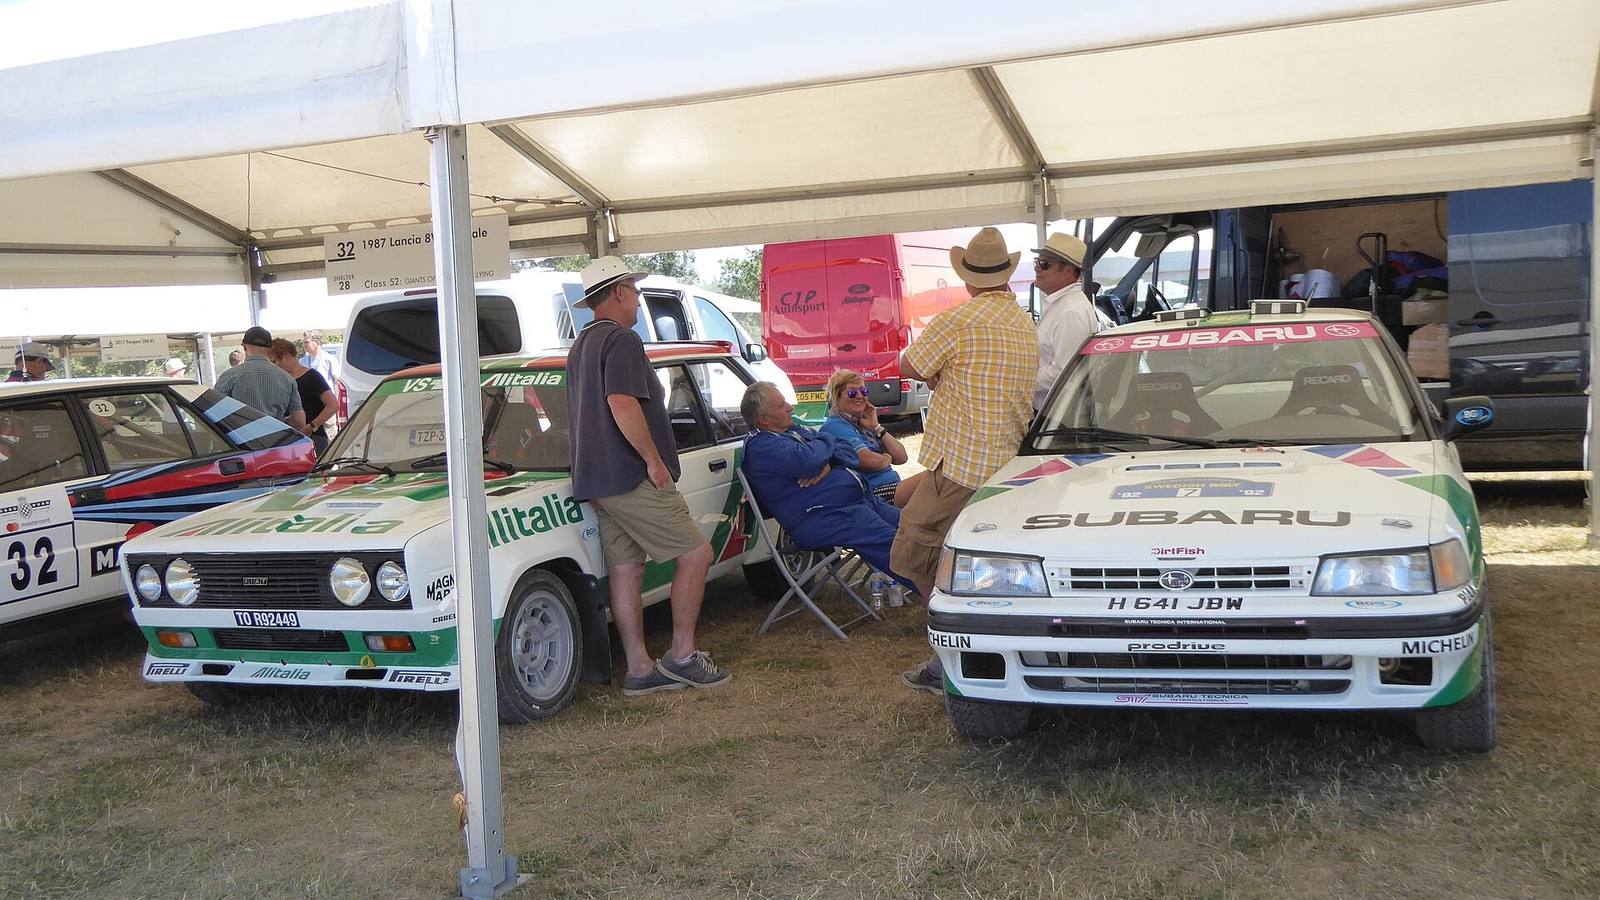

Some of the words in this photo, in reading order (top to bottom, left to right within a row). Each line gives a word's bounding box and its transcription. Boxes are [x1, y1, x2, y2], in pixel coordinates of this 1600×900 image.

[362, 238, 386, 250] 1987
[390, 234, 421, 248] Lancia
[336, 241, 355, 258] 32
[338, 280, 351, 291] 28
[364, 279, 387, 289] Class
[389, 277, 402, 287] 52:
[404, 276, 426, 285] GIANTS
[780, 290, 817, 306] CJP
[773, 301, 826, 315] Autosport
[1130, 325, 1317, 349] SUBARU
[480, 371, 563, 387] Alitalia
[1303, 374, 1351, 385] RECARO
[1137, 382, 1182, 392] RECARO
[94, 402, 110, 413] 32
[1144, 481, 1206, 490] SWEDISH
[1021, 509, 1351, 531] SUBARU
[1151, 547, 1205, 556] DirtFish
[7, 536, 58, 591] 32
[242, 576, 269, 586] FIAT
[1107, 597, 1127, 610] H
[1133, 597, 1179, 610] 641
[1187, 597, 1243, 611] JBW
[236, 611, 251, 626] TO
[253, 612, 298, 627] R92449
[1127, 640, 1226, 652] prodrive
[1401, 630, 1474, 655] MICHELIN
[145, 662, 191, 676] PIRELLI
[250, 666, 312, 680] Alitalia
[389, 669, 452, 685] PIRELLI
